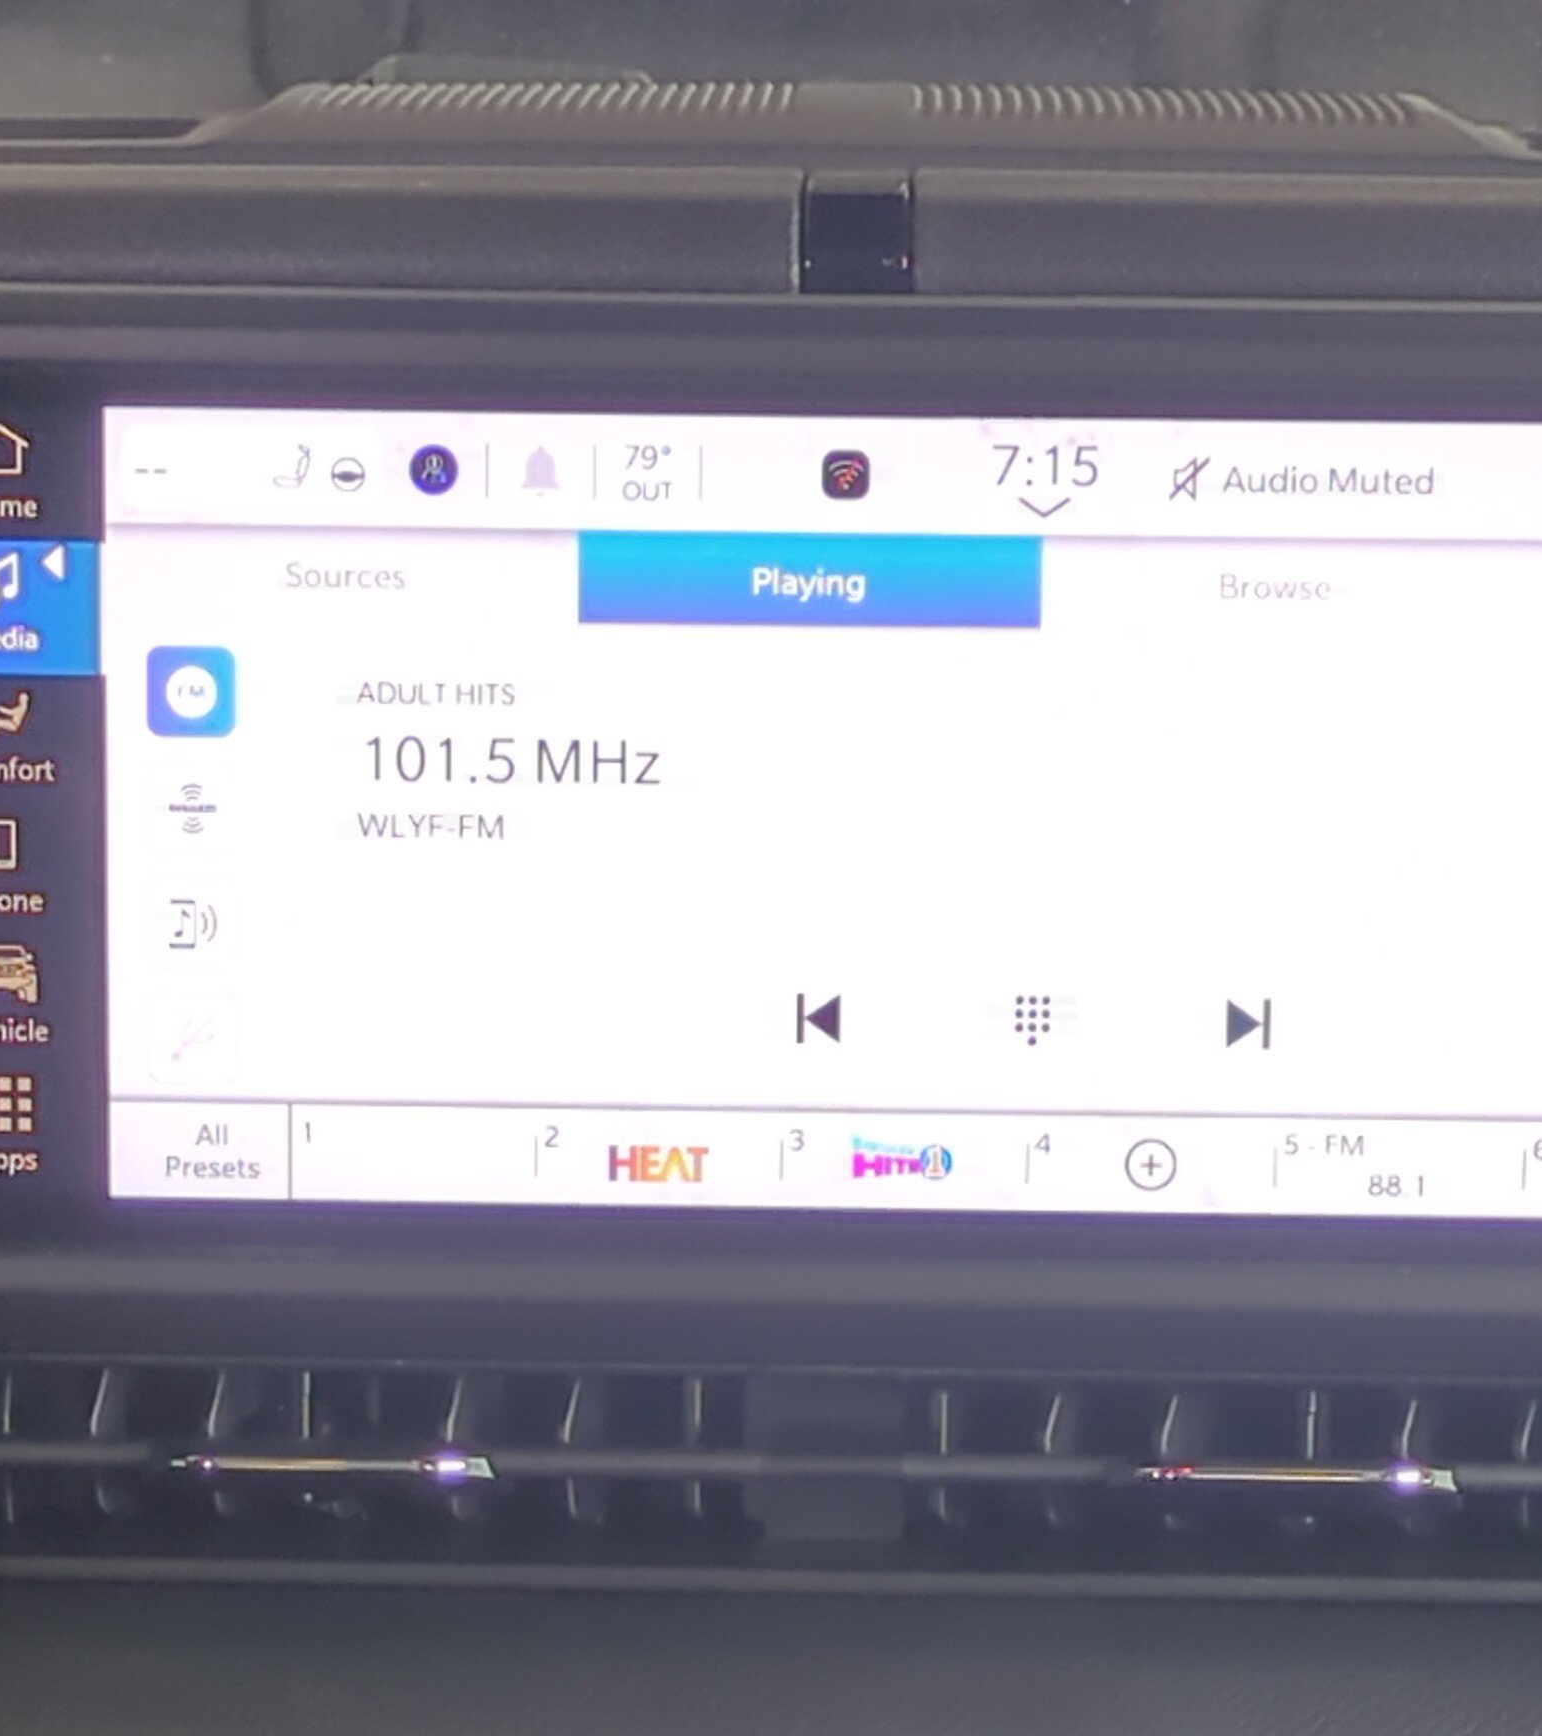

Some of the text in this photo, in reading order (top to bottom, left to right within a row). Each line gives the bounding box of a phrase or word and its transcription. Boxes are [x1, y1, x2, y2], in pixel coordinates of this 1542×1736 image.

[991, 444, 1100, 487] 7:15
[622, 481, 672, 502] OUT
[1222, 463, 1436, 496] Audio Muted
[285, 561, 406, 591] Sources
[752, 566, 867, 602] Playing
[1219, 573, 1331, 601] Browse
[356, 681, 517, 706] ADULT HITS
[366, 736, 662, 785] 101.5 MHz
[357, 813, 505, 840] WLYF-FM
[195, 1123, 229, 1146] All
[544, 1127, 560, 1148] 2
[789, 1129, 805, 1151] 3
[1034, 1133, 1051, 1155] 4
[1284, 1135, 1299, 1156] 5
[1325, 1136, 1365, 1157] FM
[165, 1155, 261, 1180] Presets
[609, 1146, 709, 1184] HEAT
